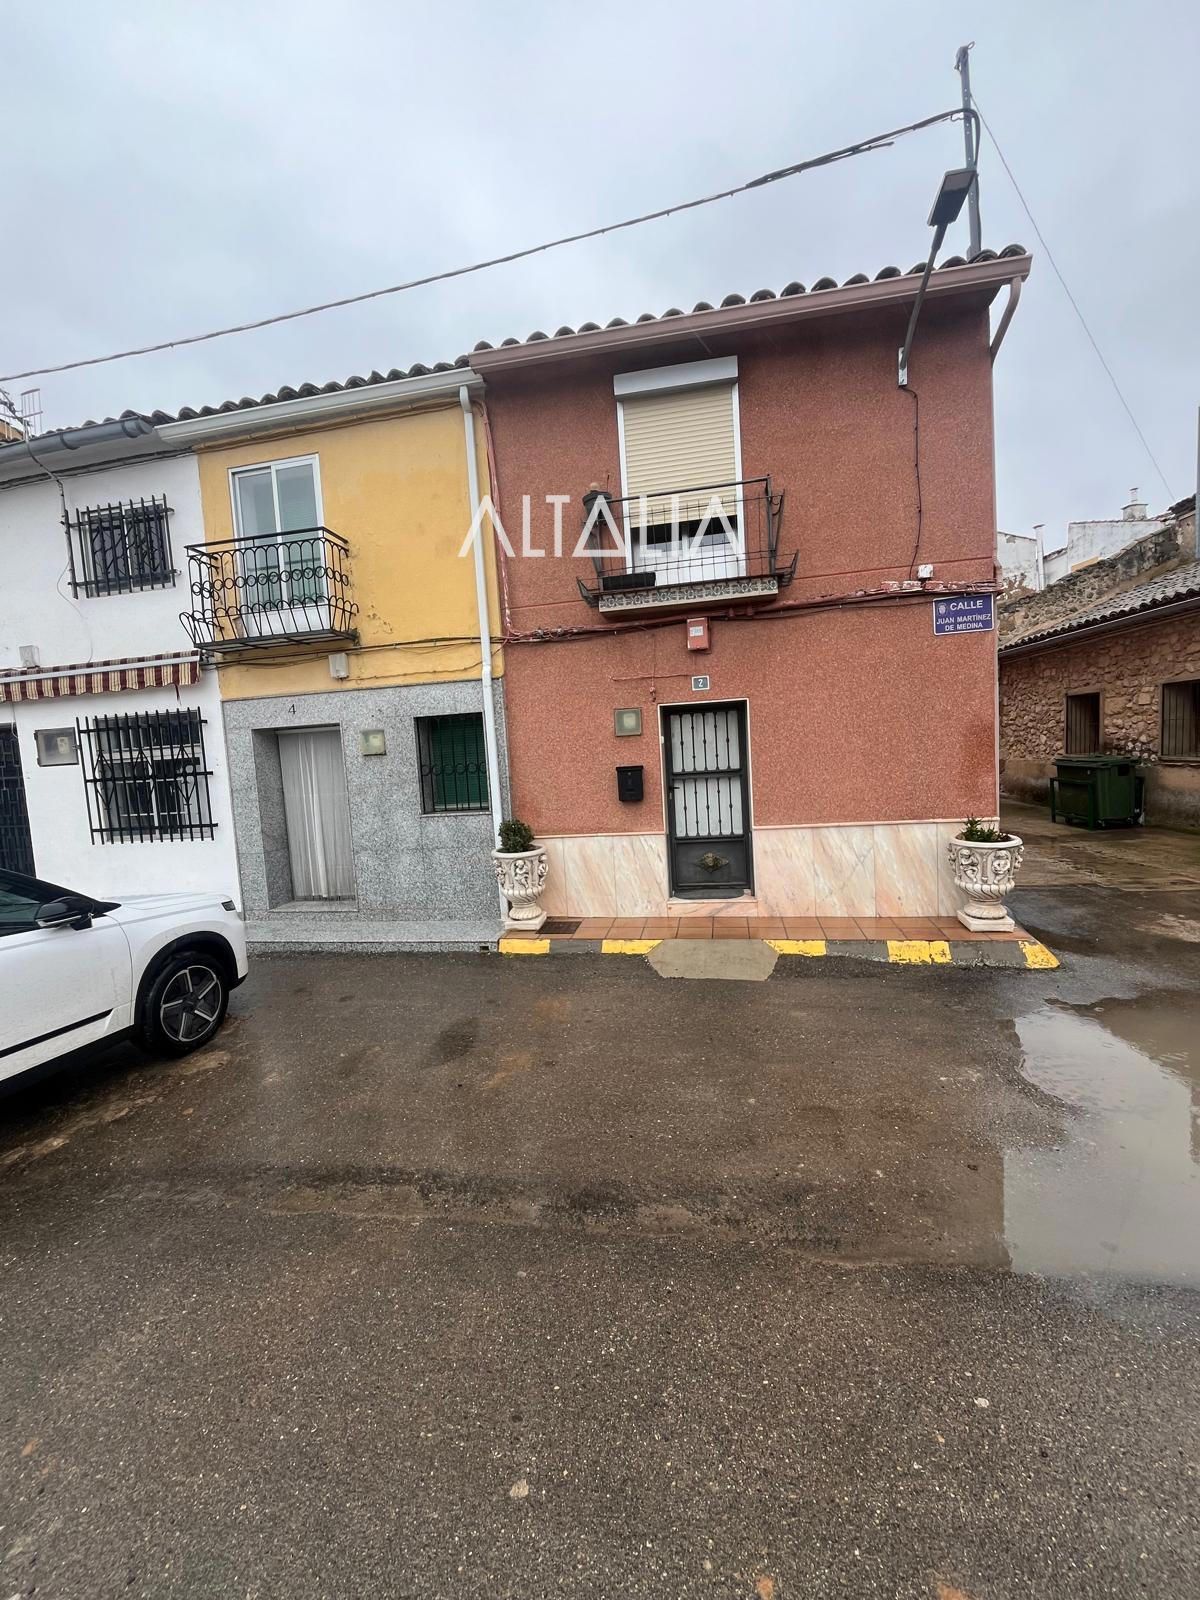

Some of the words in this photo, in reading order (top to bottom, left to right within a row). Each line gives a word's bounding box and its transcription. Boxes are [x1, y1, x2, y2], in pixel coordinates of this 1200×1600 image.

[950, 600, 983, 610] CALLE
[957, 613, 991, 622] MARTÍNEZ
[957, 622, 983, 630] MEDINA
[698, 679, 703, 687] 2
[288, 704, 296, 714] 4
